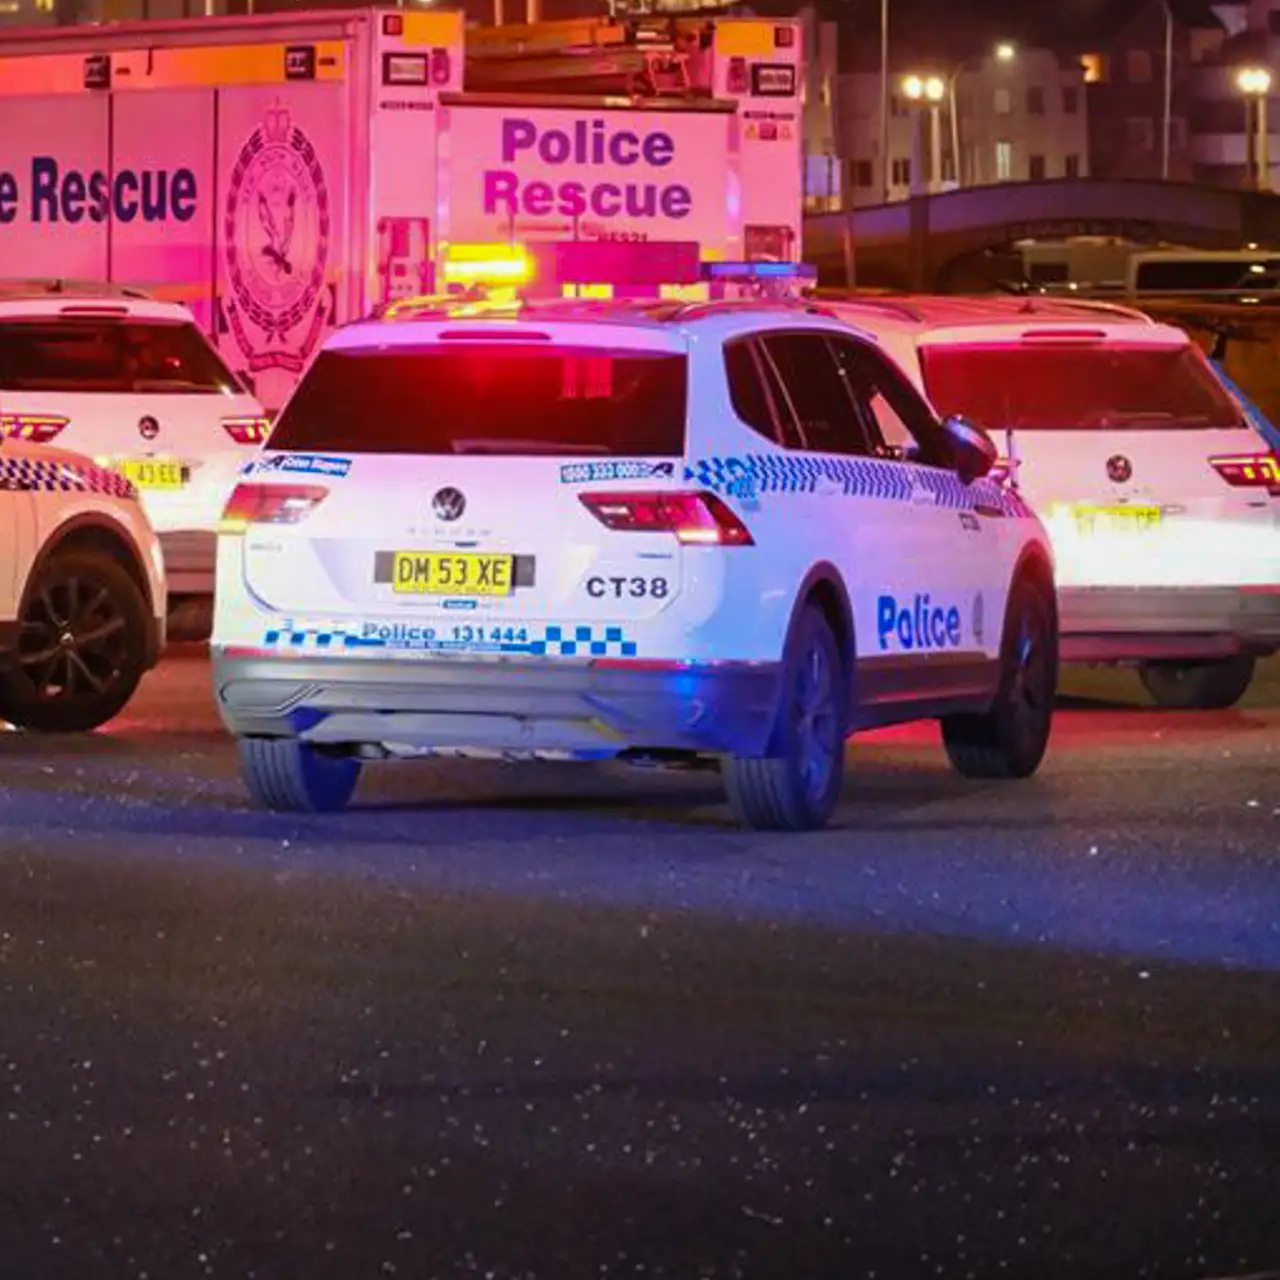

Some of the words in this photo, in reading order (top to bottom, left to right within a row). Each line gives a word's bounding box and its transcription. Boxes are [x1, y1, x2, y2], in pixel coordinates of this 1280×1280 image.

[502, 117, 674, 166] Police
[31, 156, 198, 223] Rescue
[483, 170, 692, 218] Rescue
[398, 556, 430, 584] DM
[437, 558, 468, 585] 53
[477, 559, 507, 586] XE
[586, 577, 669, 598] CT38
[363, 622, 436, 640] Police
[877, 594, 961, 650] Police
